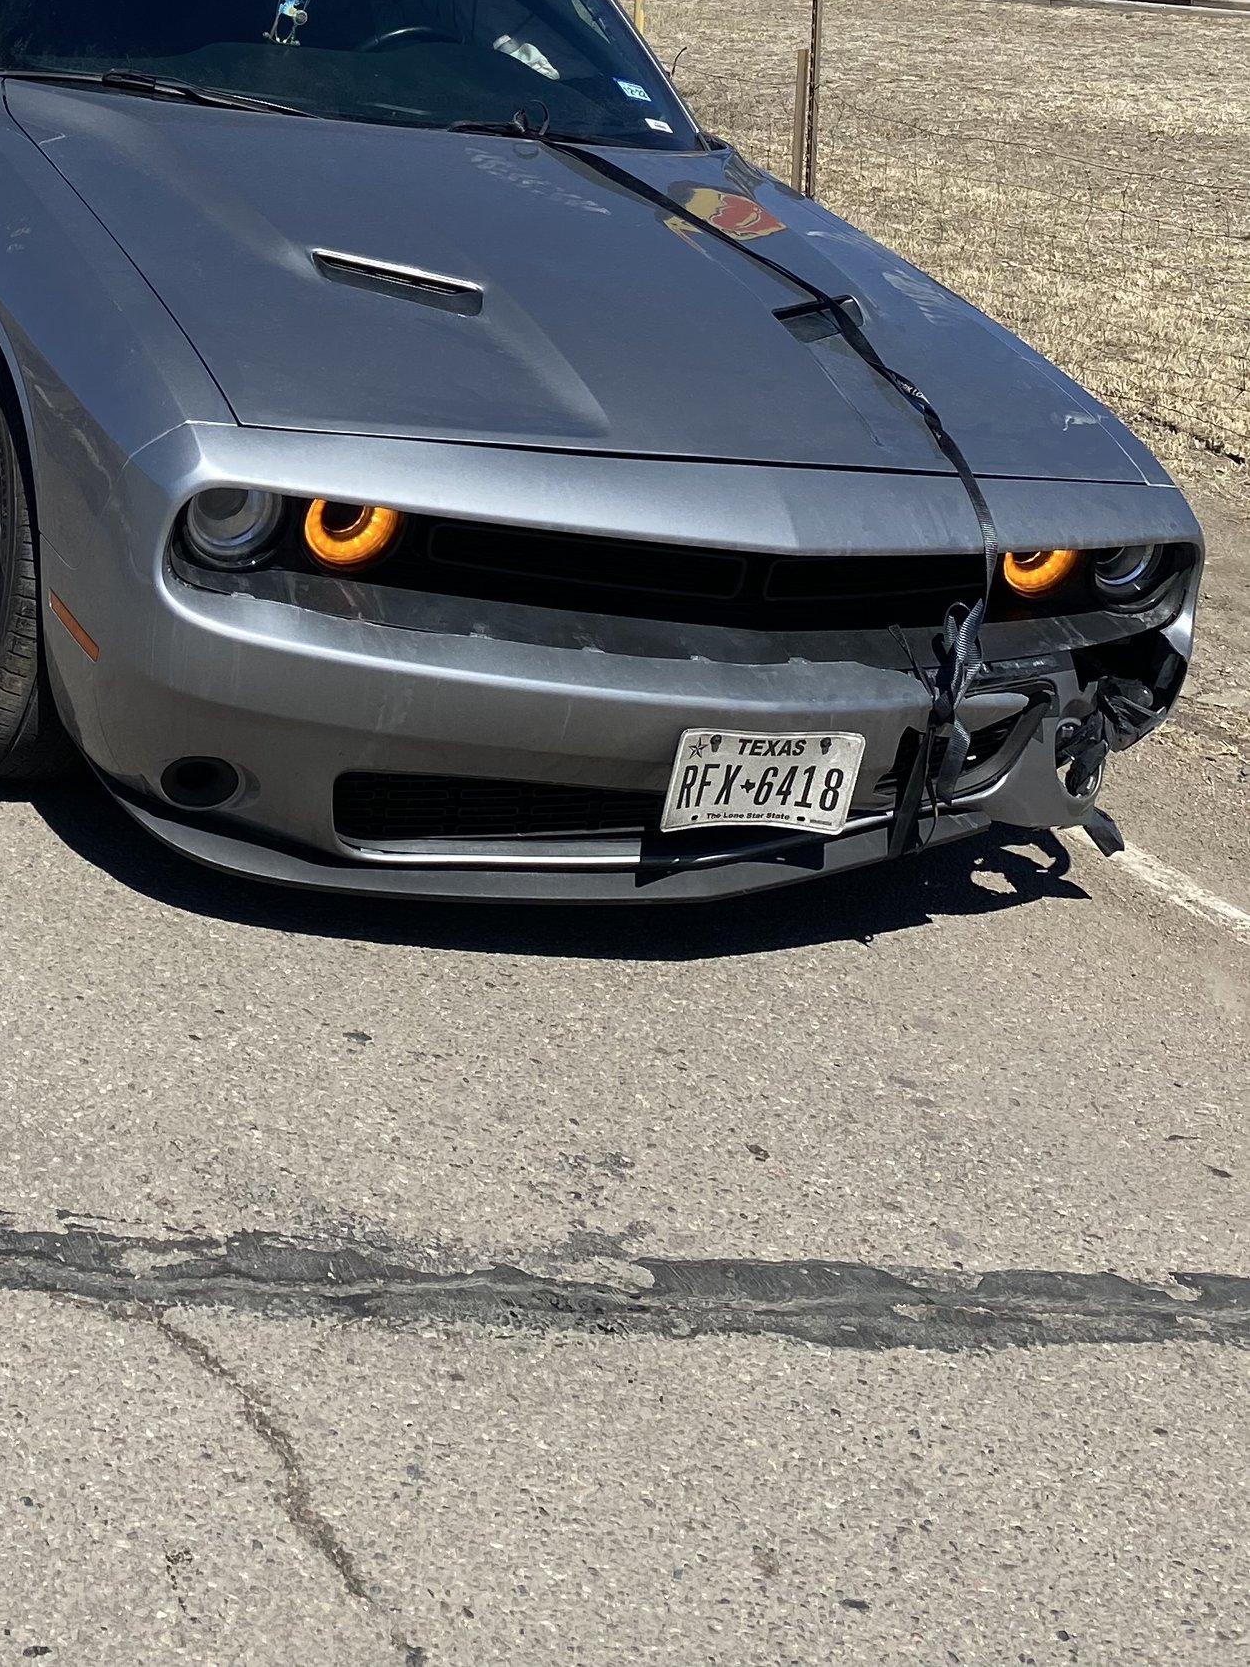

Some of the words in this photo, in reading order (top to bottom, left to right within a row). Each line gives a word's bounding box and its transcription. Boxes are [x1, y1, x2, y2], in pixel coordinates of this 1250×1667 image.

[738, 738, 807, 757] TEXAS
[676, 763, 743, 810] RFX
[753, 765, 845, 812] 6418
[706, 812, 722, 820] The
[723, 812, 745, 820] Lone
[746, 812, 765, 820] Star
[766, 812, 791, 821] State
